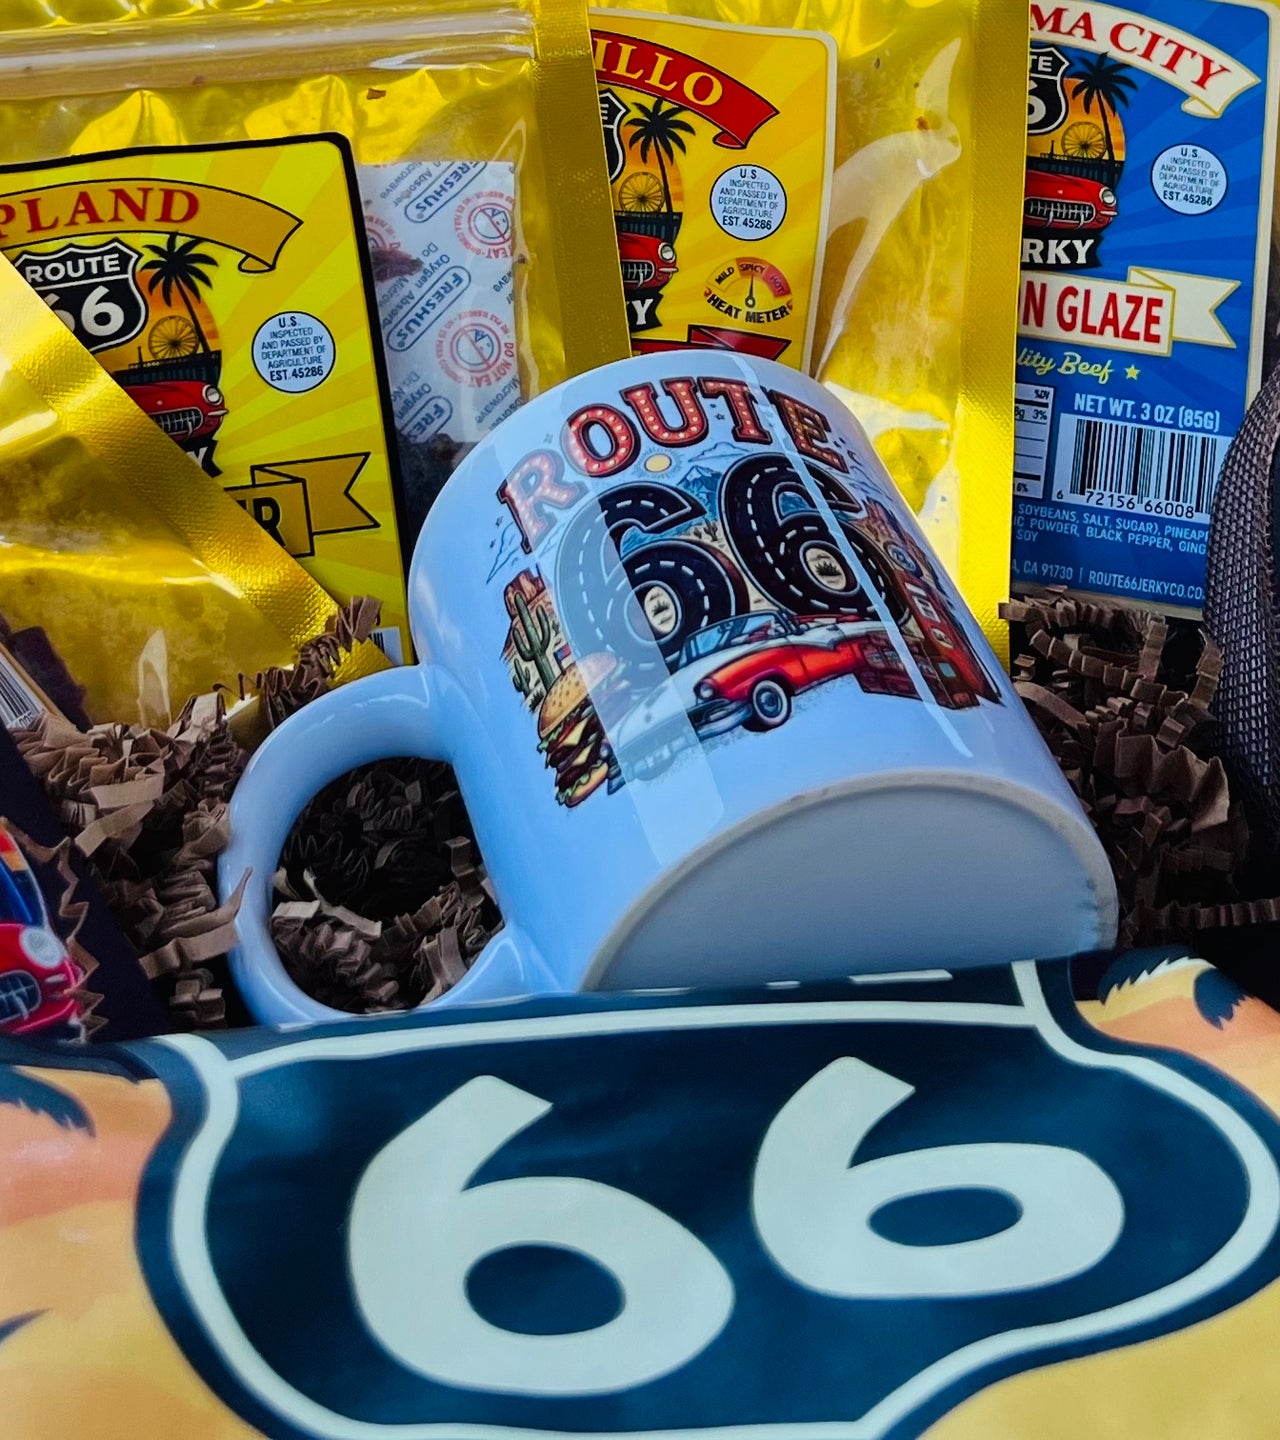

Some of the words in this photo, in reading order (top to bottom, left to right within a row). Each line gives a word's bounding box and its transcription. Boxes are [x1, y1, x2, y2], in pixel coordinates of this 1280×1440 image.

[1109, 21, 1232, 90] CITY
[25, 254, 121, 283] ROUTE
[715, 266, 735, 285] MILD
[739, 263, 766, 274] SPICY
[707, 293, 742, 319] HEAT
[744, 304, 790, 324] METER
[1056, 284, 1164, 345] GLAZE
[261, 340, 278, 350] AND
[280, 337, 311, 347] PASSED
[261, 346, 314, 360] DEPARTMENT
[291, 365, 324, 378] 45286
[1056, 351, 1115, 385] Beef
[1074, 392, 1106, 414] NET
[1109, 397, 1136, 420] WT.
[1140, 403, 1151, 421] 3
[1153, 404, 1175, 424] OZ
[1178, 405, 1220, 433] (85G)
[498, 375, 848, 553] ROUTE
[1018, 503, 1079, 524] SOYBEANS,
[1082, 512, 1112, 529] SALT,
[1056, 489, 1064, 500] 6
[1085, 490, 1136, 510] 72156
[1143, 500, 1195, 519] 66008
[1016, 528, 1039, 542] SOY
[1030, 518, 1080, 537] POWDER,
[1086, 525, 1123, 543] BLACK
[1127, 532, 1173, 552] PEPPER,
[554, 453, 909, 672] 66
[1023, 560, 1038, 575] CA
[1041, 562, 1073, 580] 91730
[1088, 570, 1206, 600] ROUTE66JERKYCO.CO
[348, 1056, 1125, 1394] 66
